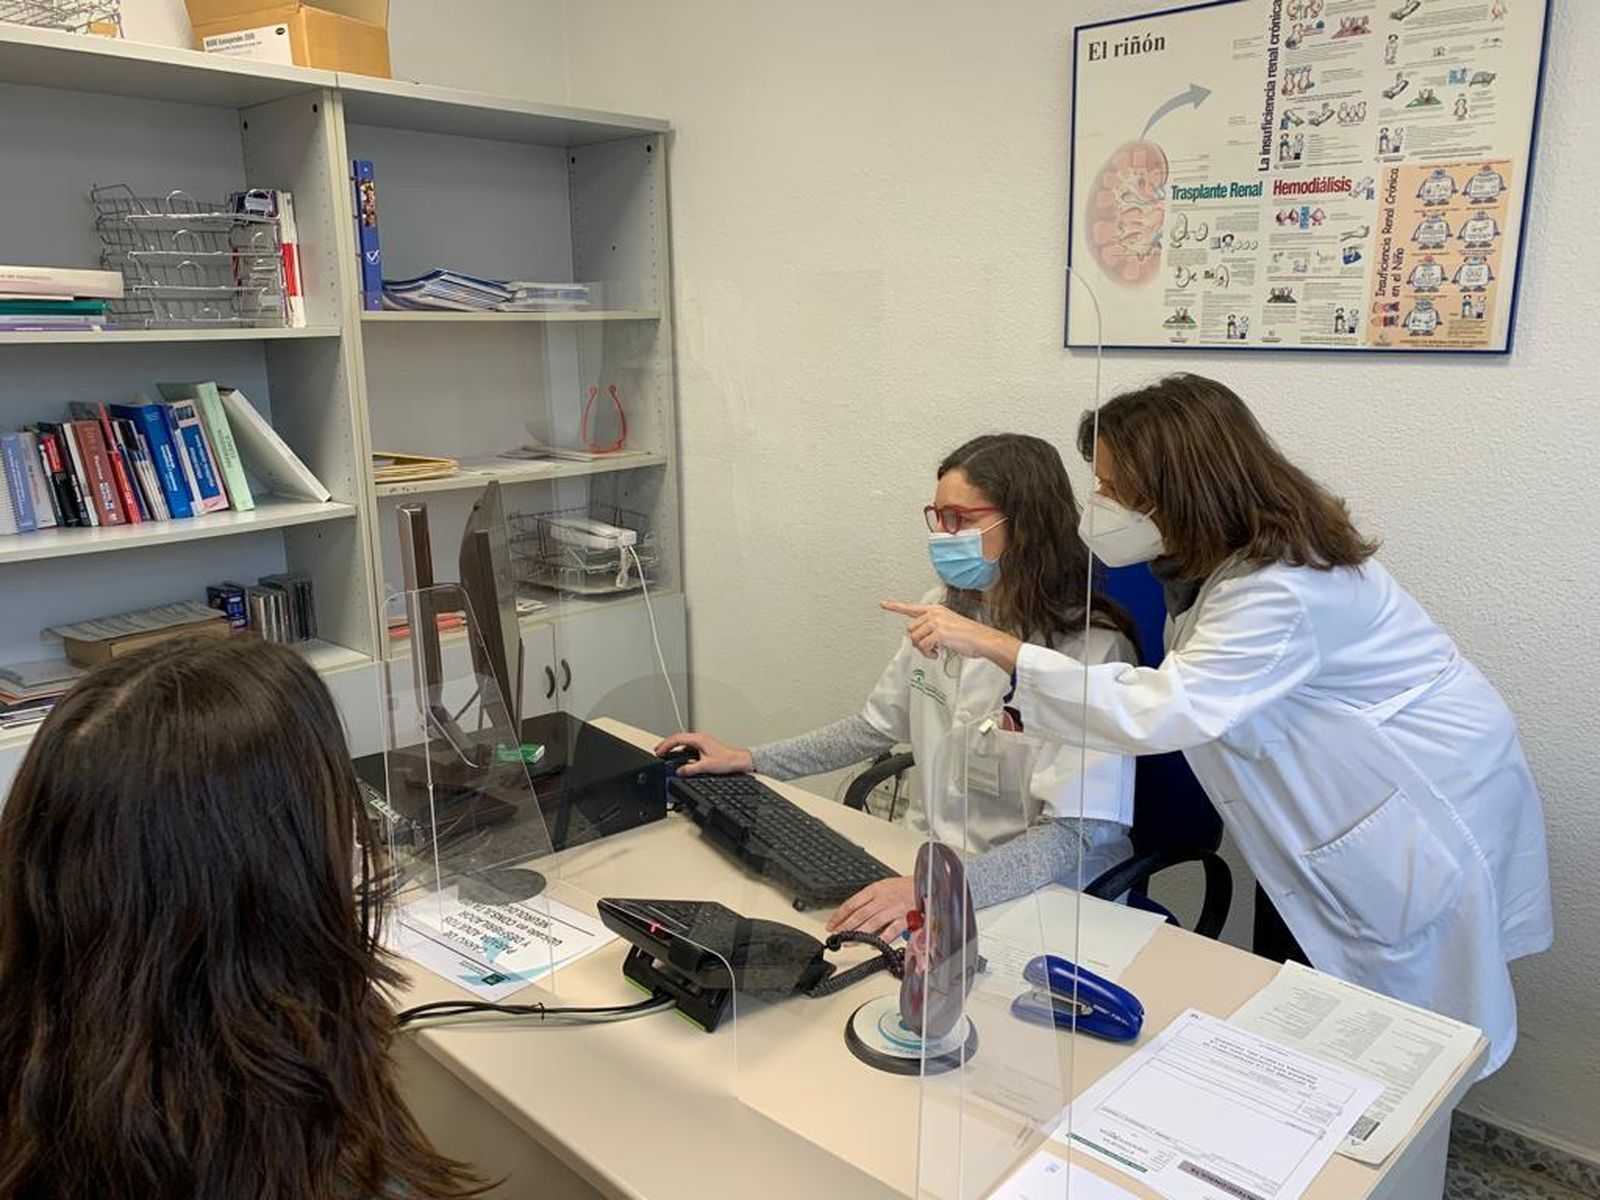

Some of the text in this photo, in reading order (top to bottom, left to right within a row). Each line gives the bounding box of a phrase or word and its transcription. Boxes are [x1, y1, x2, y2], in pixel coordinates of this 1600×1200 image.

[1088, 32, 1165, 61] El riñón
[1267, 47, 1279, 78] renal
[1259, 80, 1276, 156] insuficiencia
[1258, 157, 1270, 171] La
[1171, 181, 1263, 203] Trasplante Renal
[1273, 176, 1352, 196] Hemodiálisis
[1375, 168, 1399, 297] Insuficiencia Renal Crónica
[1392, 248, 1404, 271] Niño
[1392, 286, 1400, 297] en
